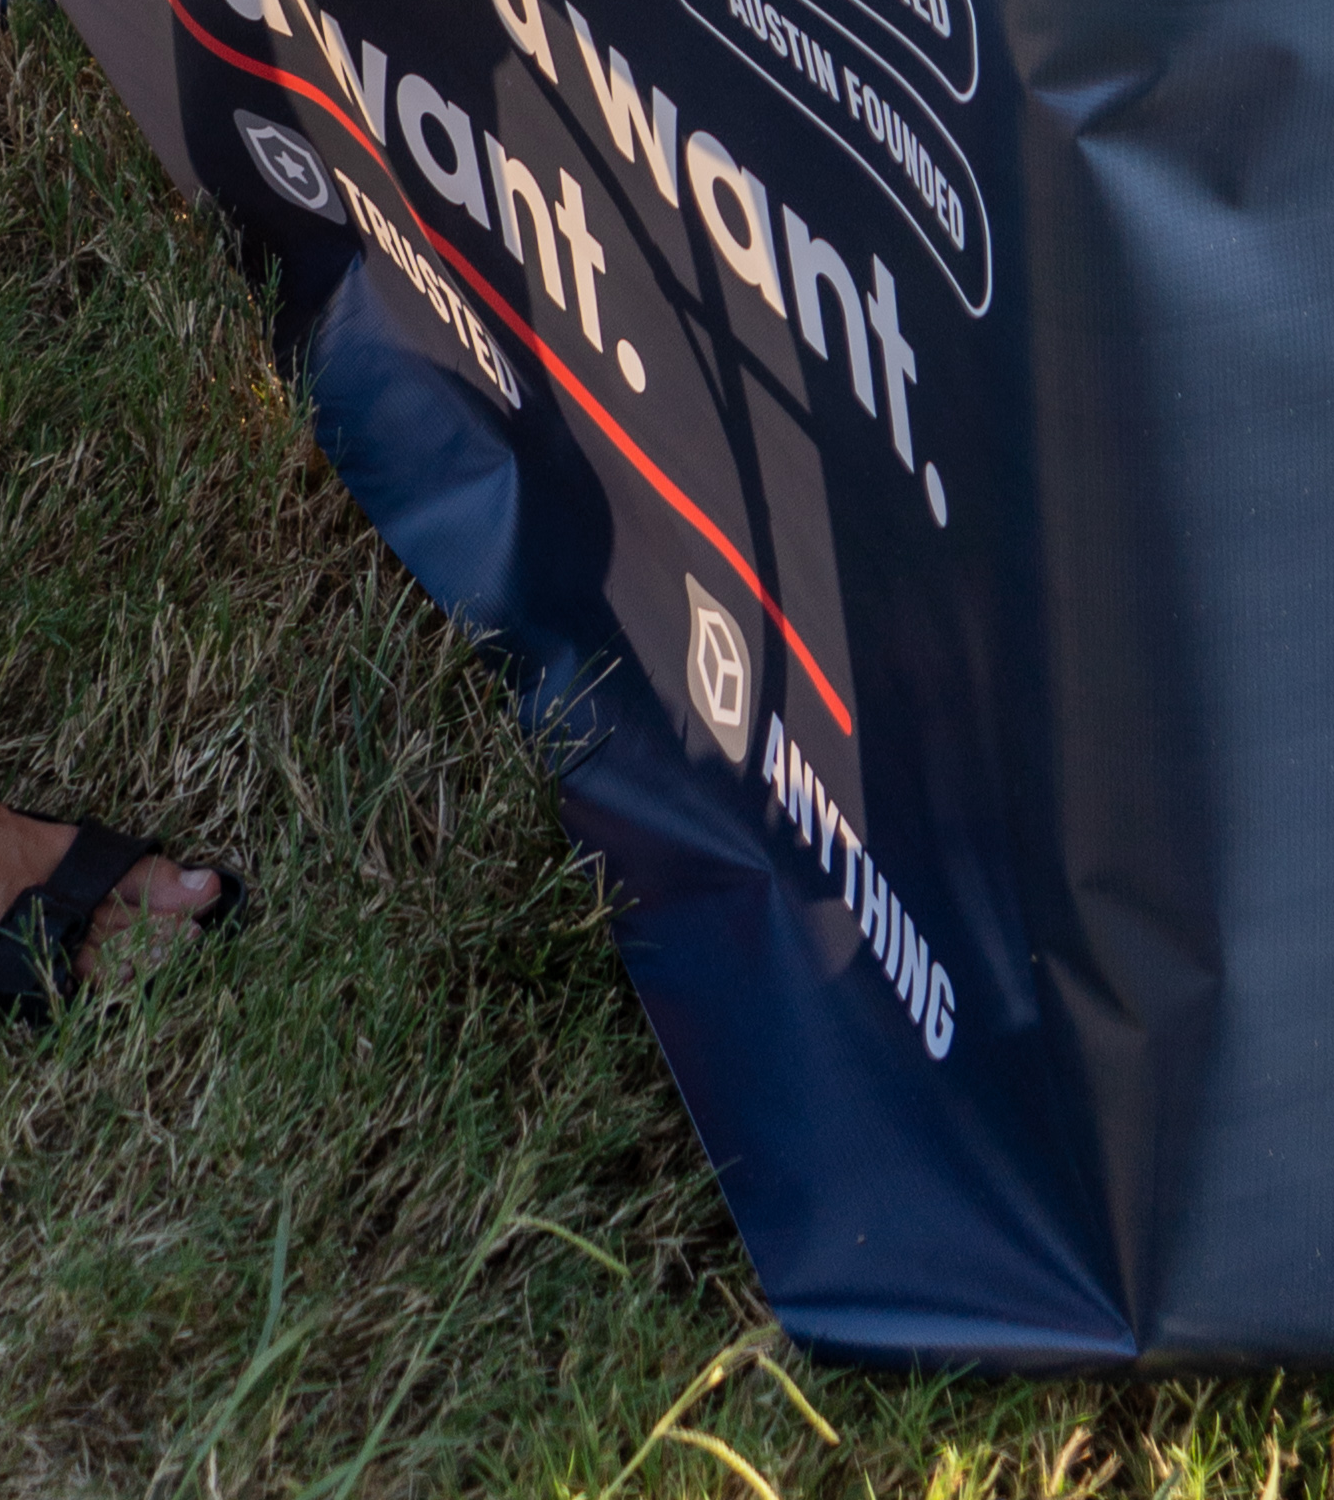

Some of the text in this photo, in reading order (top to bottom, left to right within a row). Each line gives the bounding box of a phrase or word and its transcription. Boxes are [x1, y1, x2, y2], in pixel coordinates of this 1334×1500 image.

[843, 65, 965, 252] FOUNDED
[333, 167, 522, 410] TRUSTED
[762, 710, 956, 1061] ANYTHING
